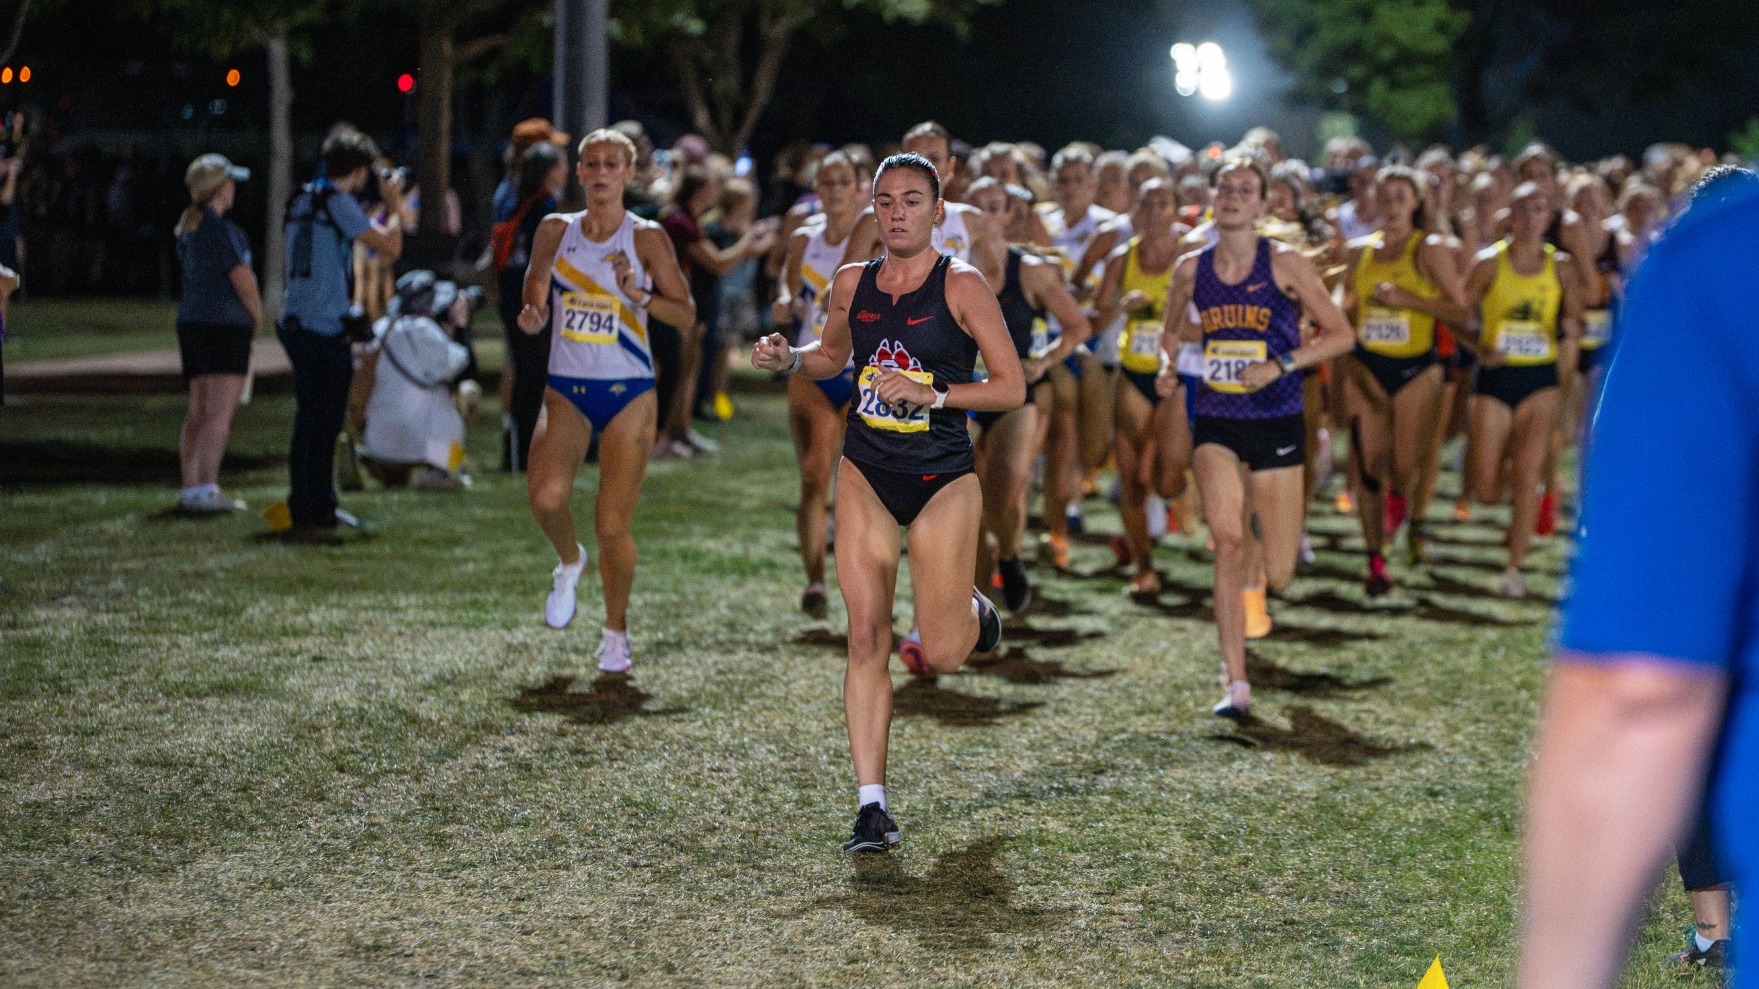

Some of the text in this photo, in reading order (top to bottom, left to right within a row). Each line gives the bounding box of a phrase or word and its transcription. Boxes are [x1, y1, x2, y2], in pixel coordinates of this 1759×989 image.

[565, 308, 613, 335] 2794
[1200, 304, 1272, 333] BRUINS
[1209, 359, 1252, 380] 218
[861, 388, 924, 420] 2832
